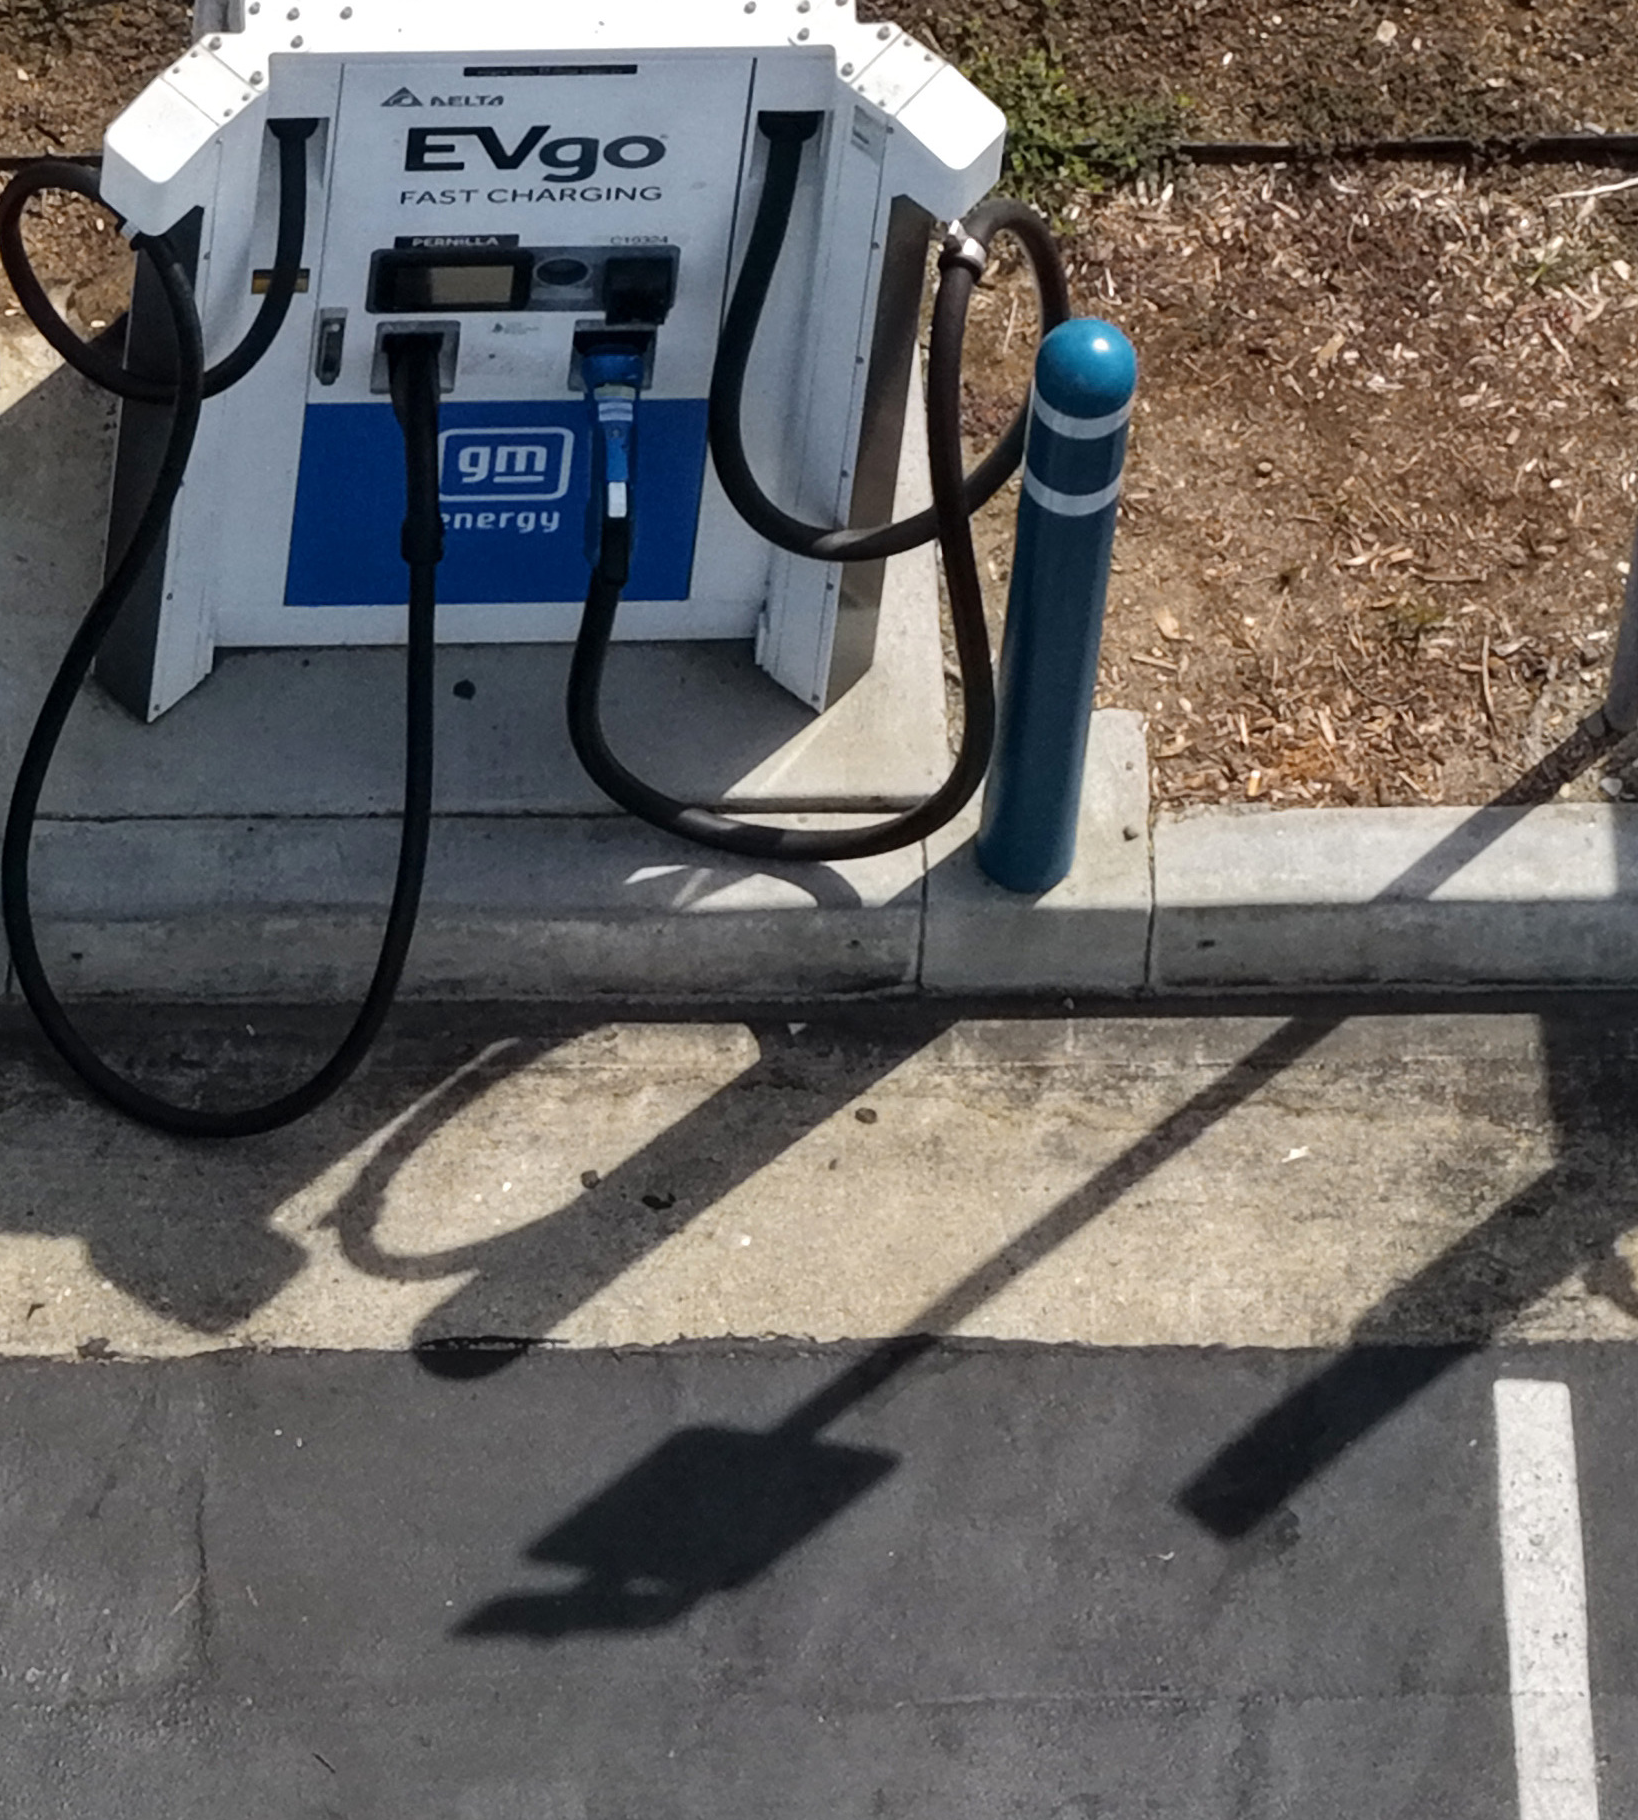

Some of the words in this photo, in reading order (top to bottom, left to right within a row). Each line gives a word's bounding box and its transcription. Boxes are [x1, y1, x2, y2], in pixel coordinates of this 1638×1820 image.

[404, 125, 666, 183] EVgo
[400, 189, 479, 205] FAST
[487, 186, 662, 204] CHARGING
[411, 236, 500, 247] PERNILLA
[458, 445, 548, 483] gm
